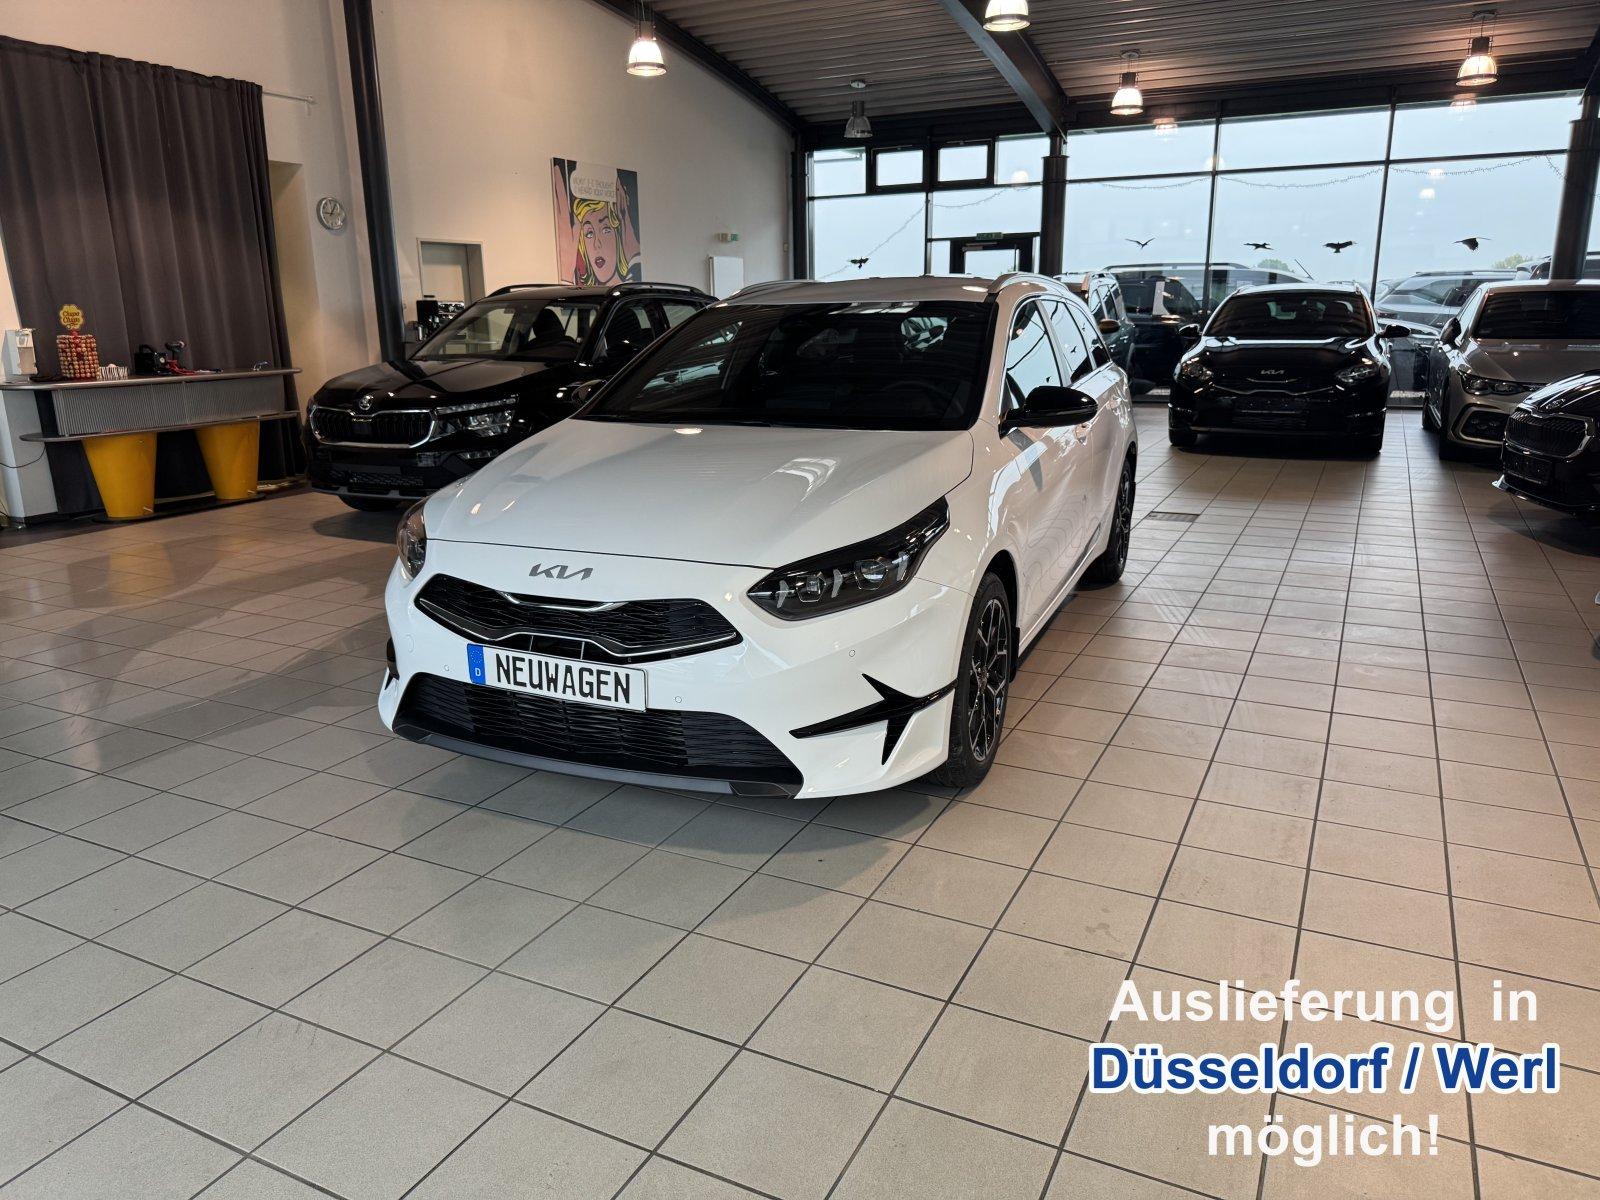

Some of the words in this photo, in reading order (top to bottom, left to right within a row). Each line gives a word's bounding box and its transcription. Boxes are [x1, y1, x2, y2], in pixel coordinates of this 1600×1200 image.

[528, 563, 594, 581] KIA
[475, 667, 482, 677] D
[495, 653, 630, 704] NEUWAGEN
